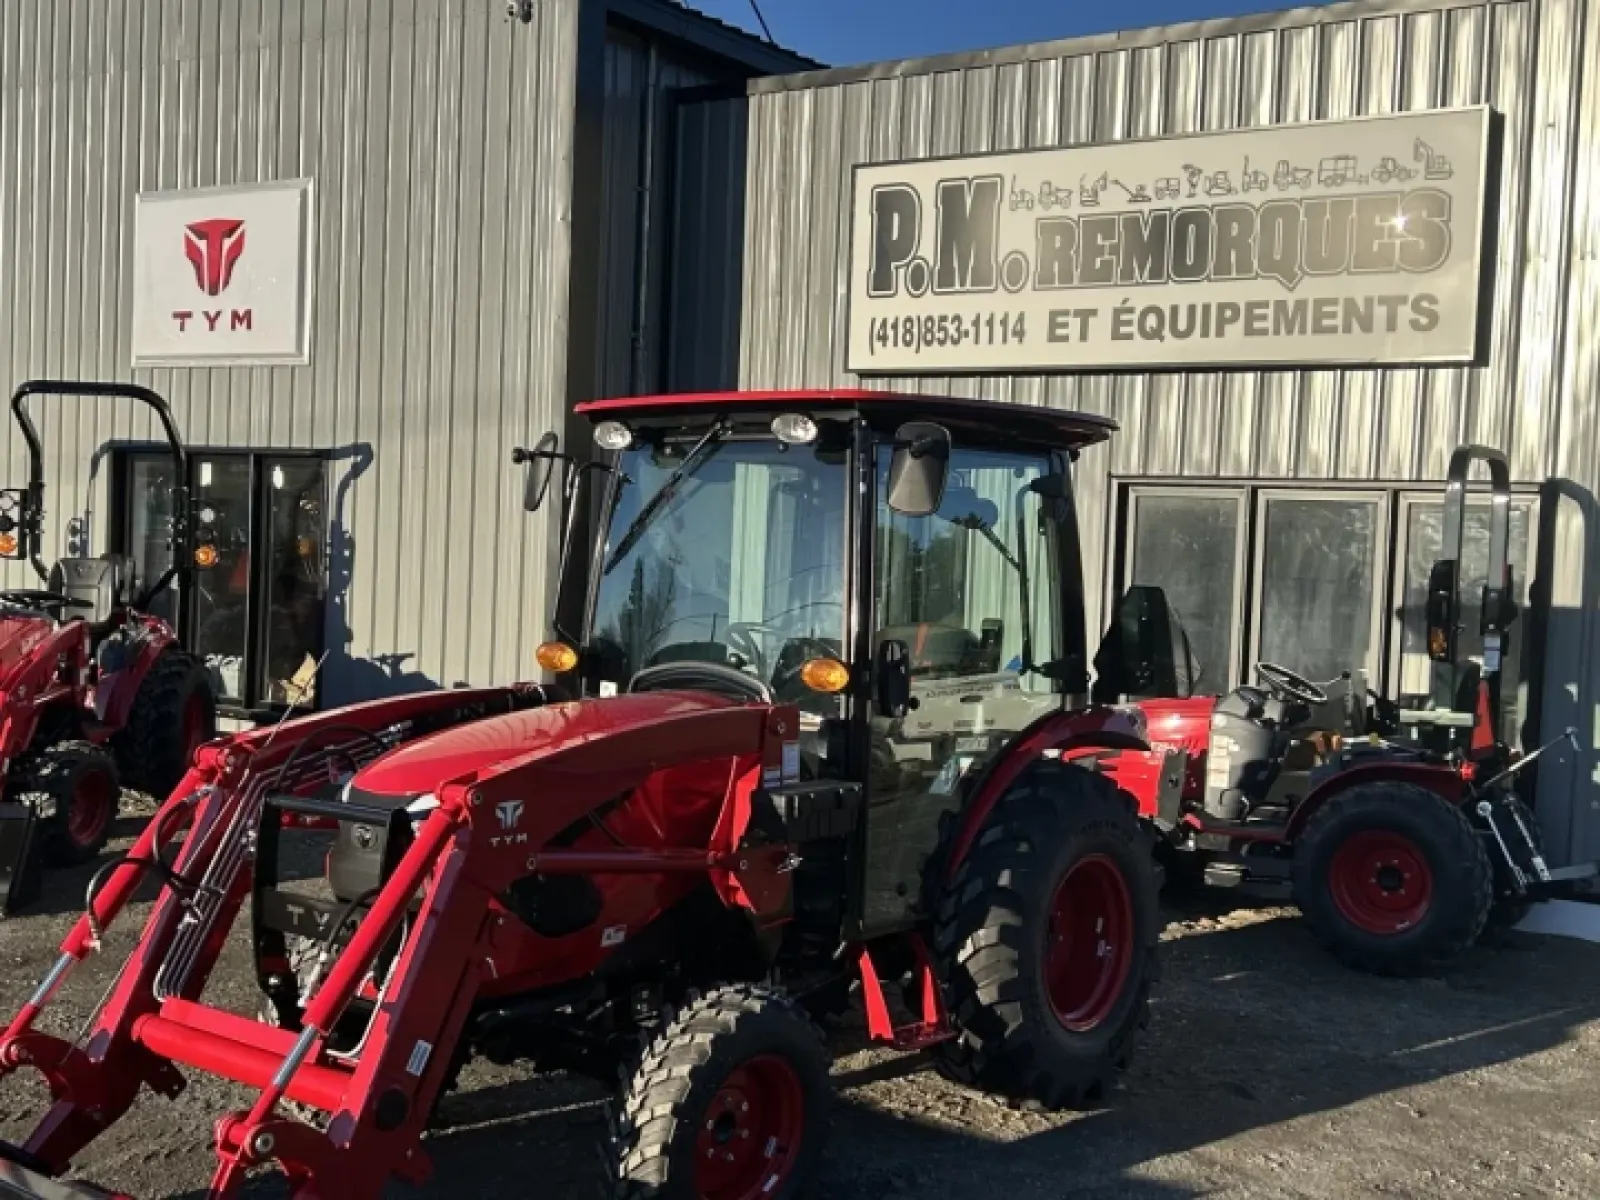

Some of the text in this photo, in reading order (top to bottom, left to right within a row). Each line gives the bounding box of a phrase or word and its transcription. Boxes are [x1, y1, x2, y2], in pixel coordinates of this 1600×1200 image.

[867, 173, 1453, 298] P.M. REMORQUES
[172, 308, 252, 332] TYM
[869, 311, 1026, 356] (418)853-1114
[1047, 293, 1440, 342] ET ÉQUIPEMENTS
